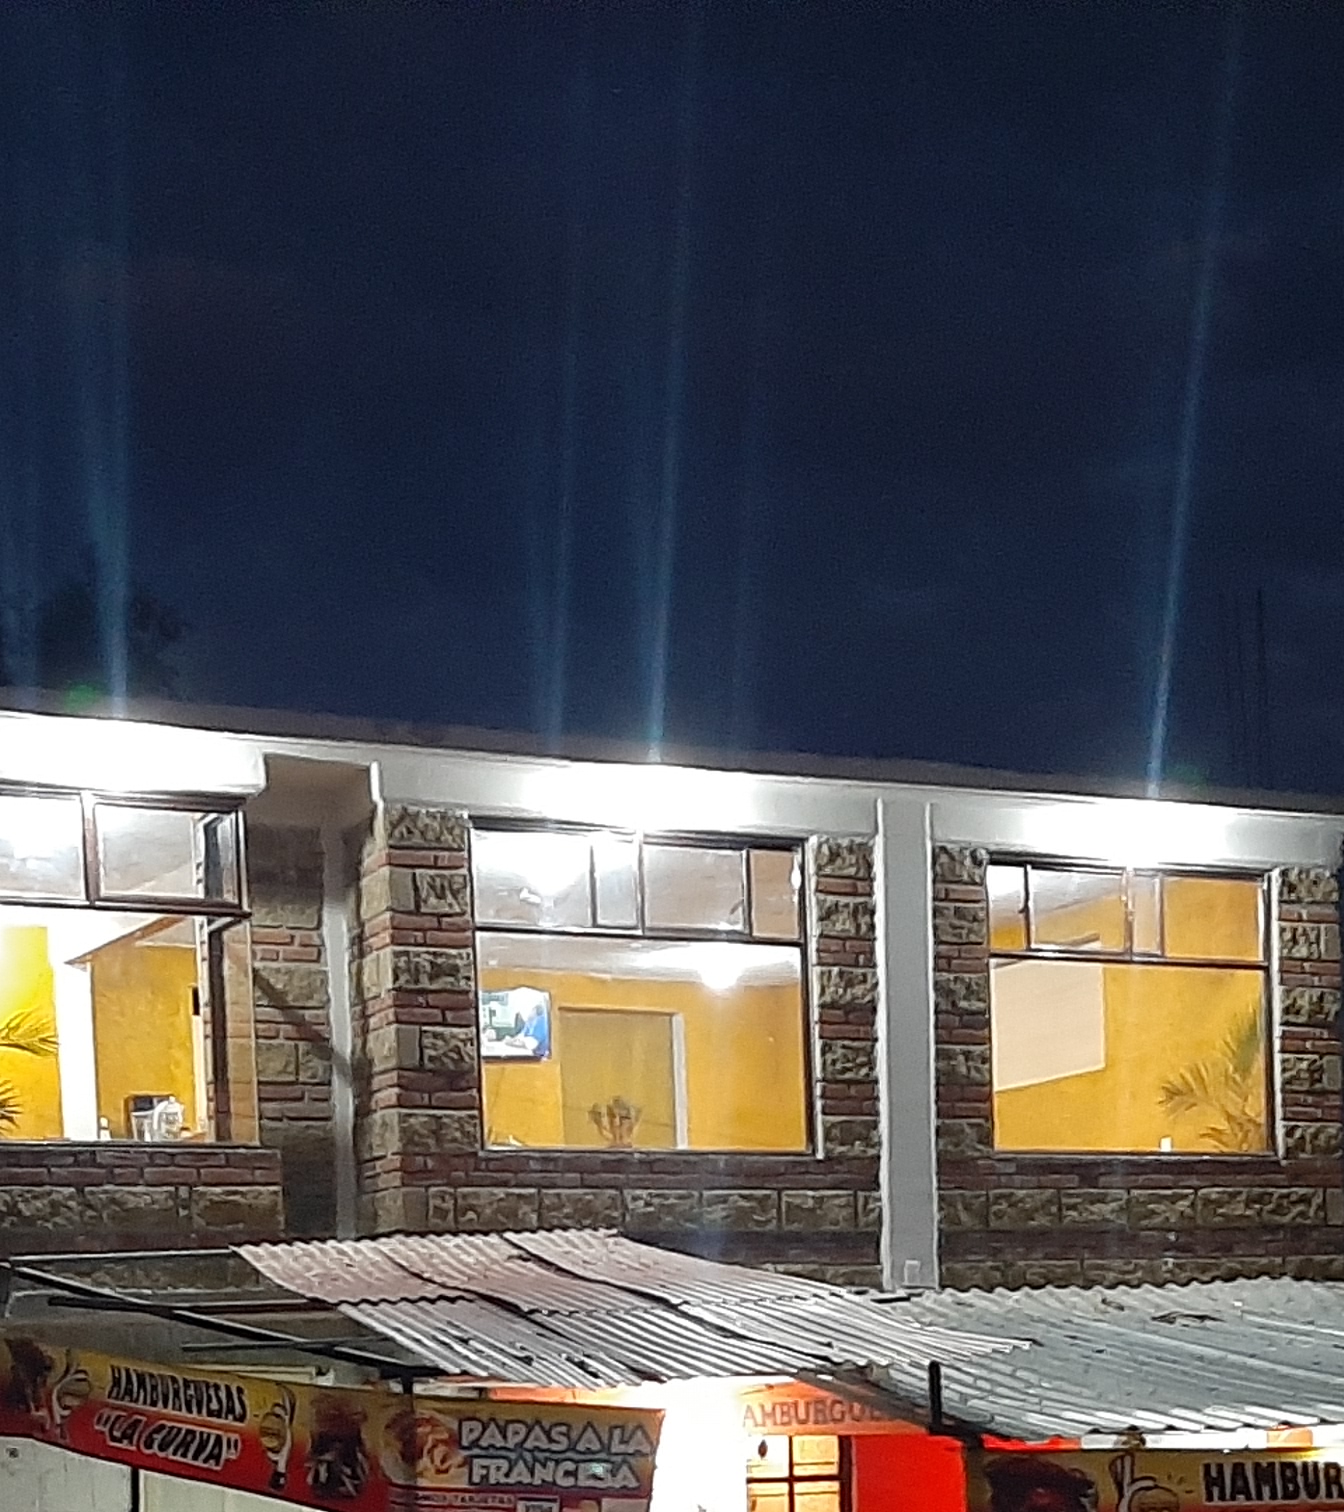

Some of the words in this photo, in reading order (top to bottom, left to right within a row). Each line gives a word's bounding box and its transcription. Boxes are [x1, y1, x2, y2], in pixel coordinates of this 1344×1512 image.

[107, 1364, 248, 1424] HAMBURGUESAS
[459, 1417, 571, 1451] PAPAS
[574, 1421, 603, 1452] A
[609, 1423, 652, 1455] LA
